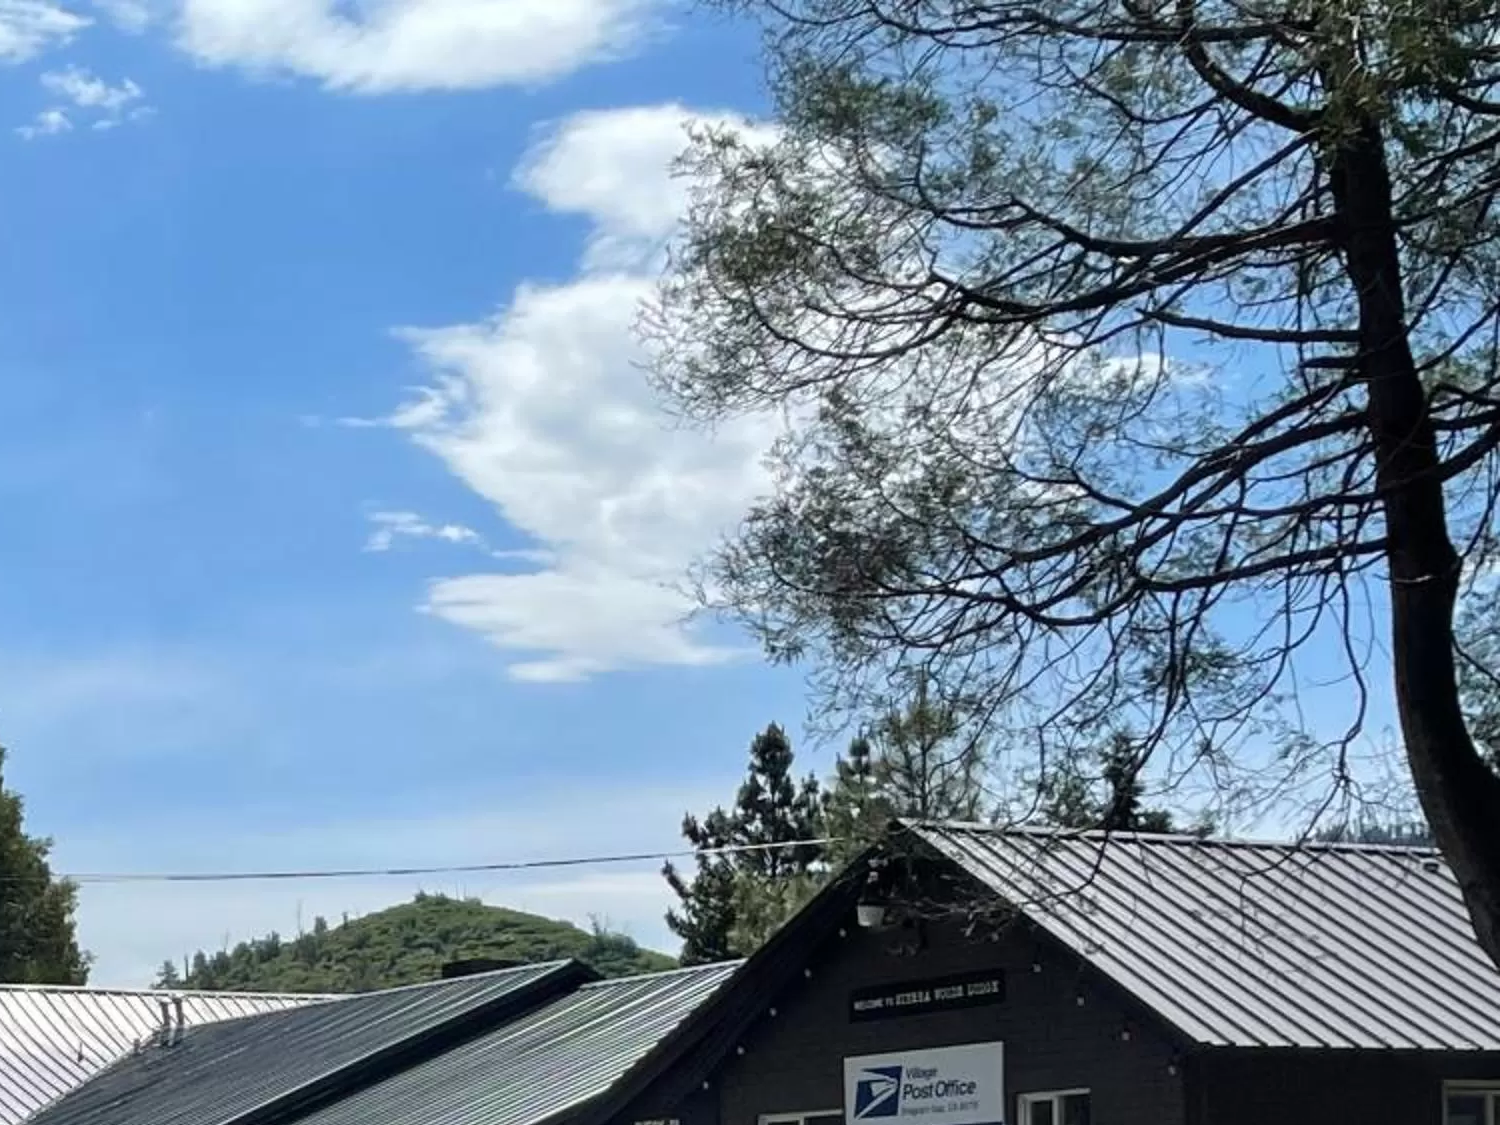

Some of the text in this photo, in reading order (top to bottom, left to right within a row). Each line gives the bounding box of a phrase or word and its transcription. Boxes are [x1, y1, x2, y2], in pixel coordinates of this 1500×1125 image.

[906, 1067, 938, 1080] Village
[903, 1079, 977, 1100] Post Office
